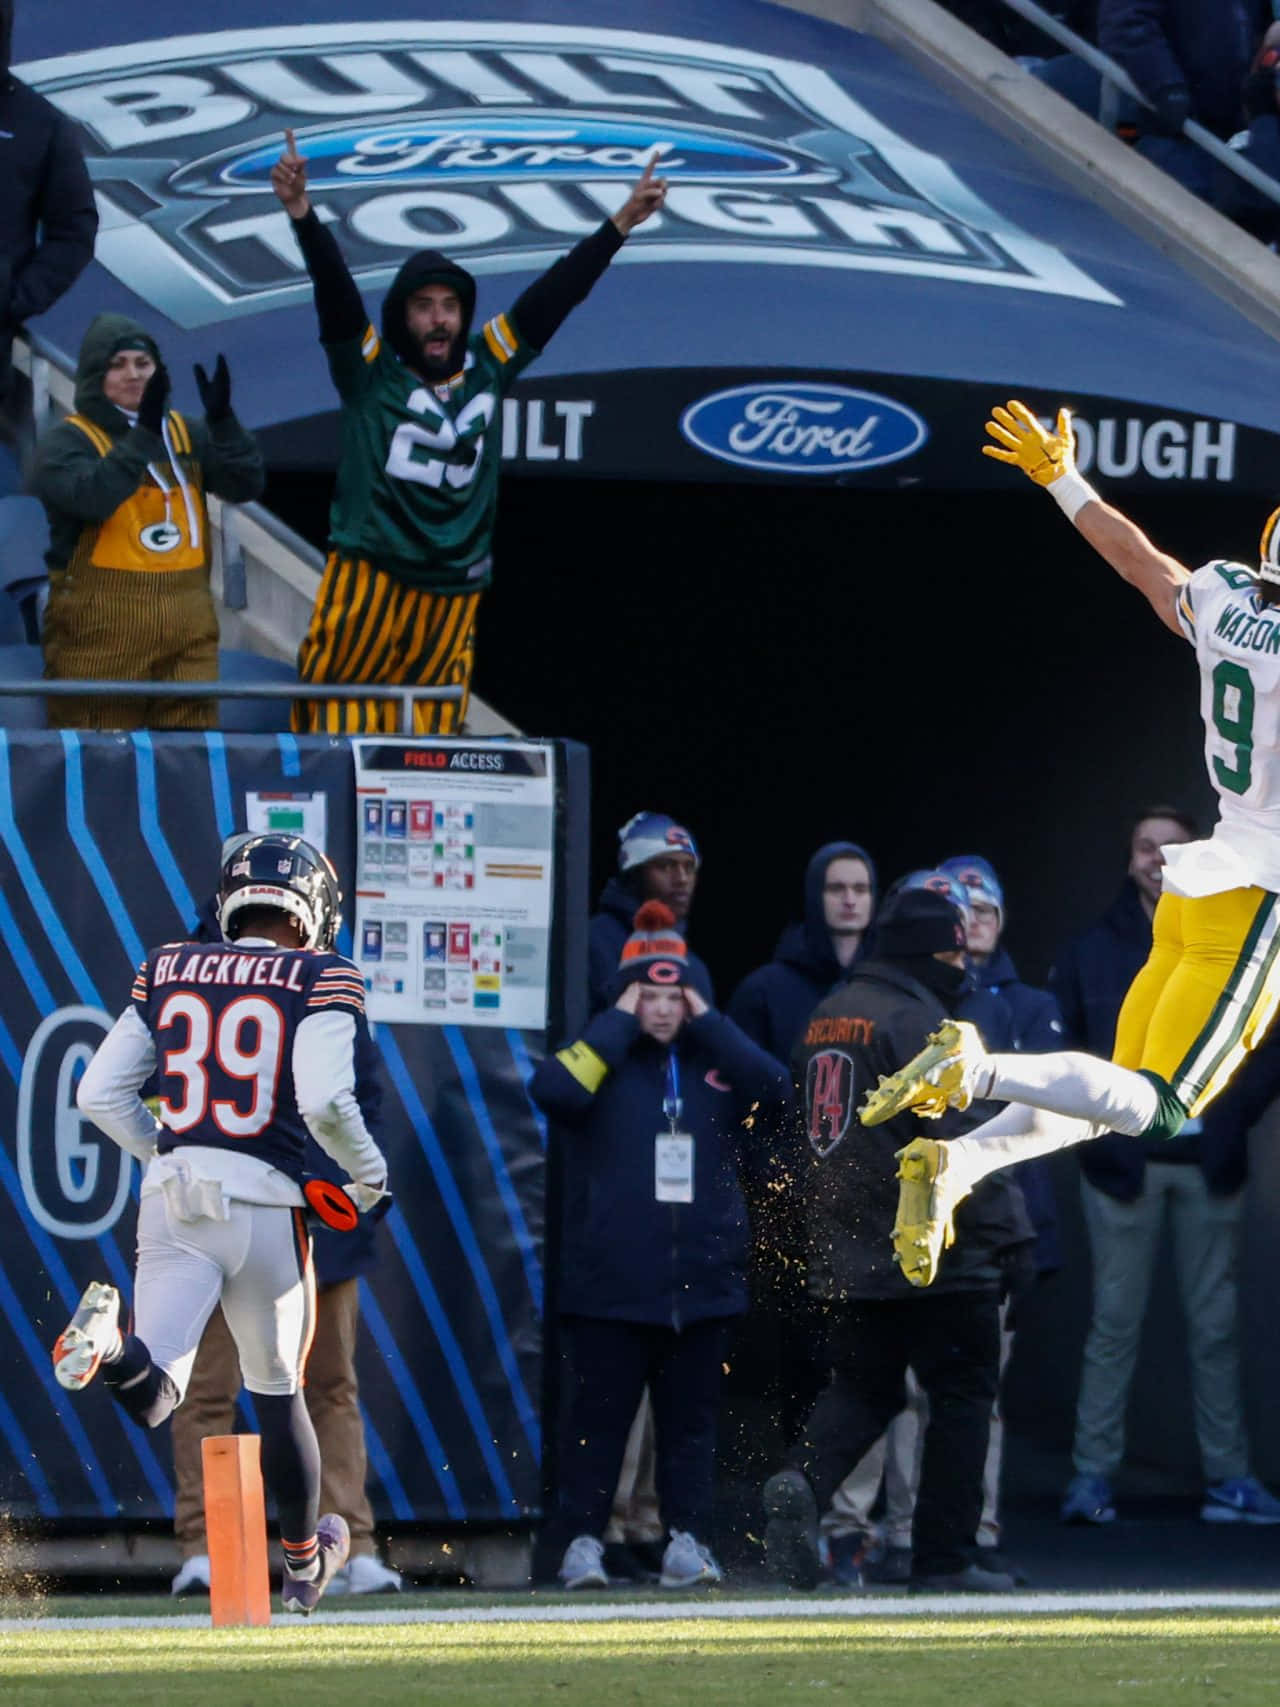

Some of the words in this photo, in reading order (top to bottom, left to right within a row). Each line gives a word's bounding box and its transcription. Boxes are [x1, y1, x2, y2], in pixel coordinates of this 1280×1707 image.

[43, 49, 766, 151] BUILT
[336, 130, 686, 176] Ford
[205, 183, 972, 272] TOUGH
[502, 398, 594, 460] ILT
[728, 395, 879, 458] Ford
[1018, 416, 1236, 481] OUGH
[403, 751, 447, 768] FIELD
[449, 752, 505, 770] ACCESS
[1212, 659, 1256, 796] 9
[153, 953, 304, 992] BLACKWELL
[157, 990, 287, 1139] 39
[804, 1016, 875, 1046] SECURITY
